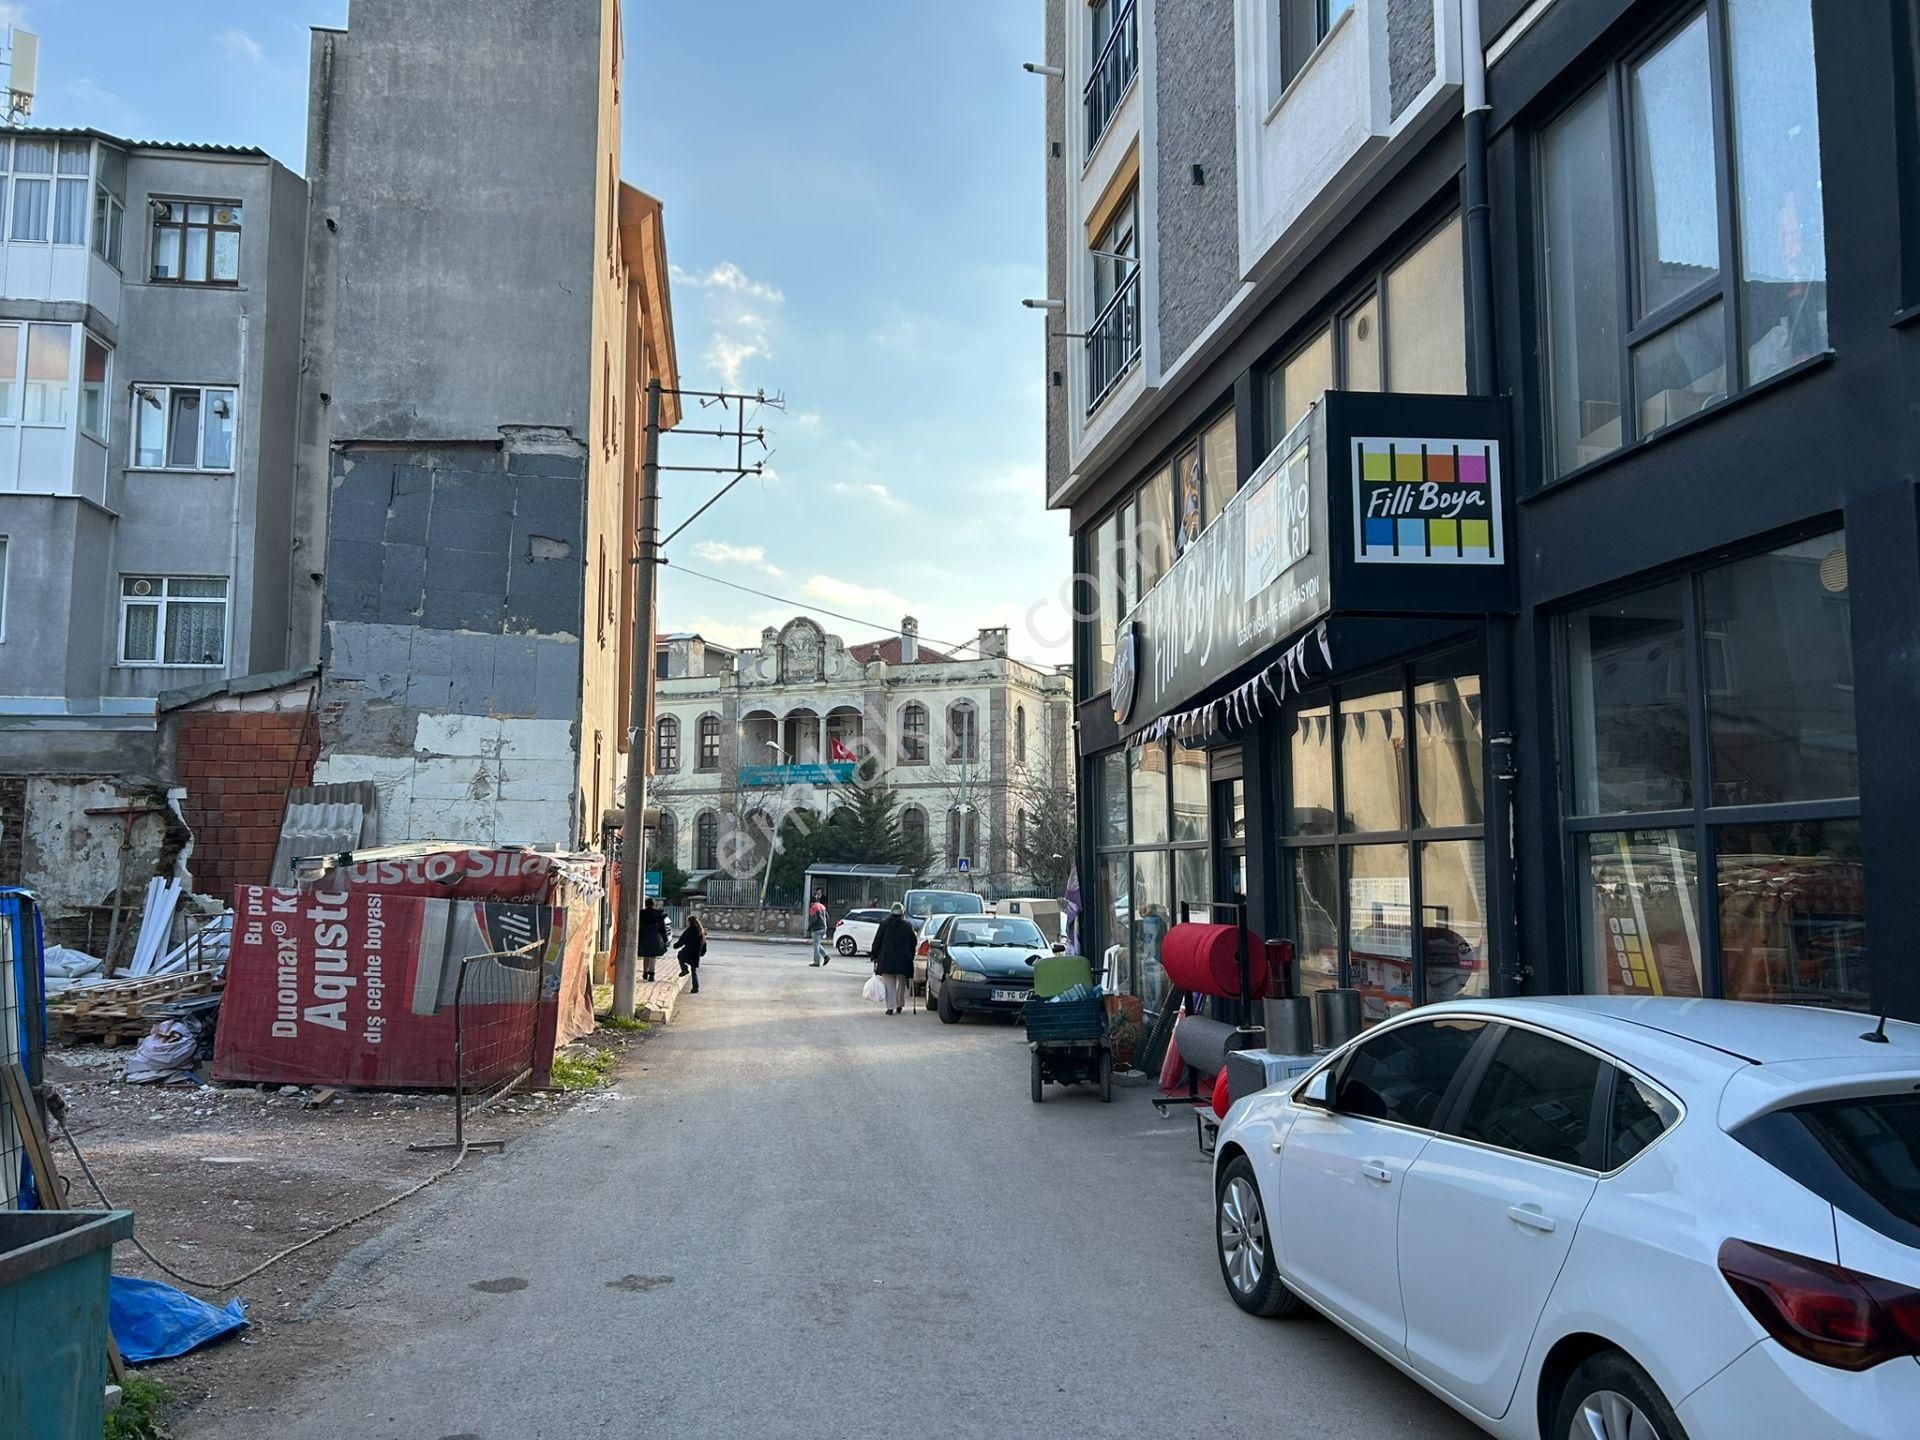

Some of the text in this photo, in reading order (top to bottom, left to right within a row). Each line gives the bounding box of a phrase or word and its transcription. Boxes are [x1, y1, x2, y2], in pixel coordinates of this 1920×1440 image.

[1367, 481, 1486, 518] Filli Boya
[1182, 546, 1233, 667] Boya
[244, 885, 267, 945] Bu pro
[363, 892, 387, 1044] dış cephe boyası
